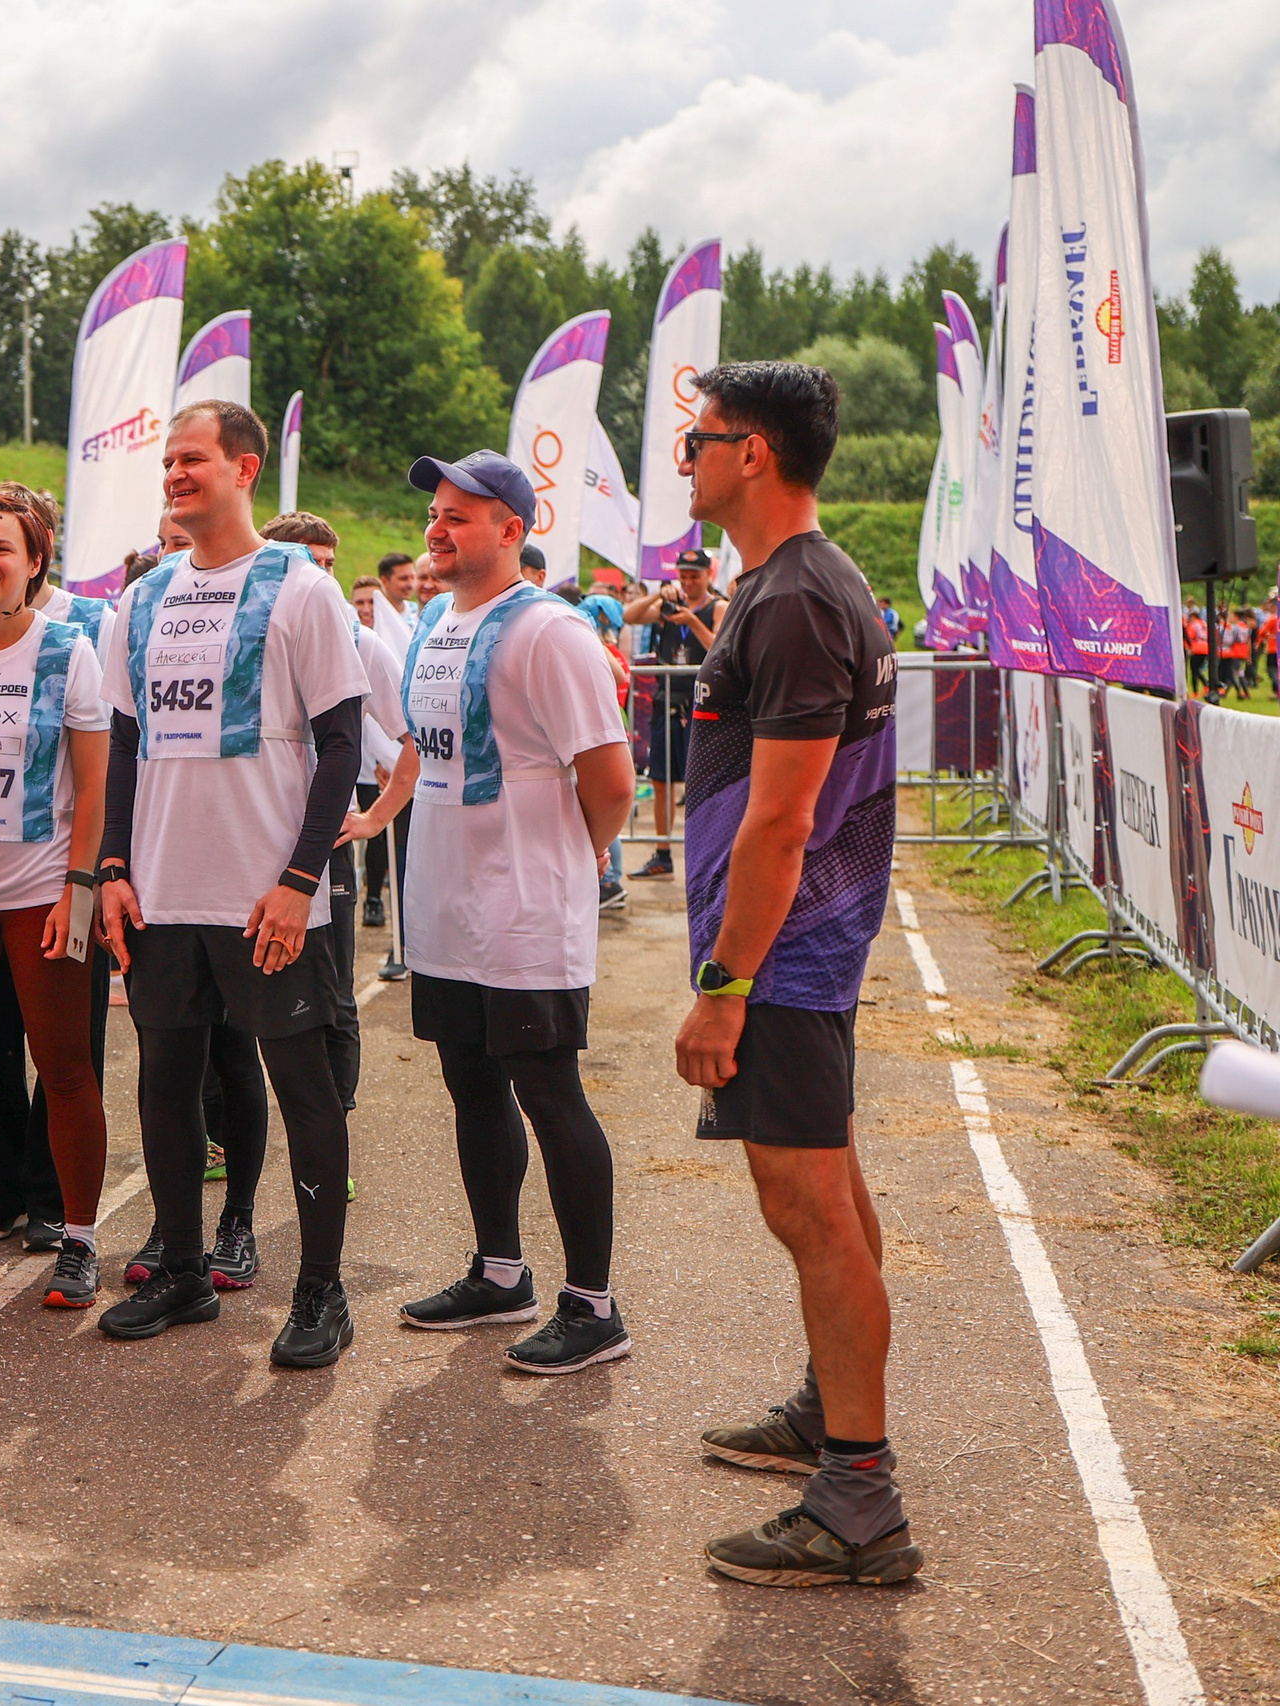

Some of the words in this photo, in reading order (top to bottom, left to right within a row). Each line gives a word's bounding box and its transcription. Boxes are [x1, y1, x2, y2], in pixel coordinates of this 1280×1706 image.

[531, 430, 563, 535] evo
[164, 593, 192, 604] ГОНКА
[195, 591, 236, 601] ГЕРОЕВ
[161, 618, 222, 638] apex
[444, 637, 470, 647] ГЕРОЕВ
[155, 648, 208, 664] Алексей
[151, 678, 214, 713] 5452
[164, 732, 202, 740] ГАЗПРОМБАНК
